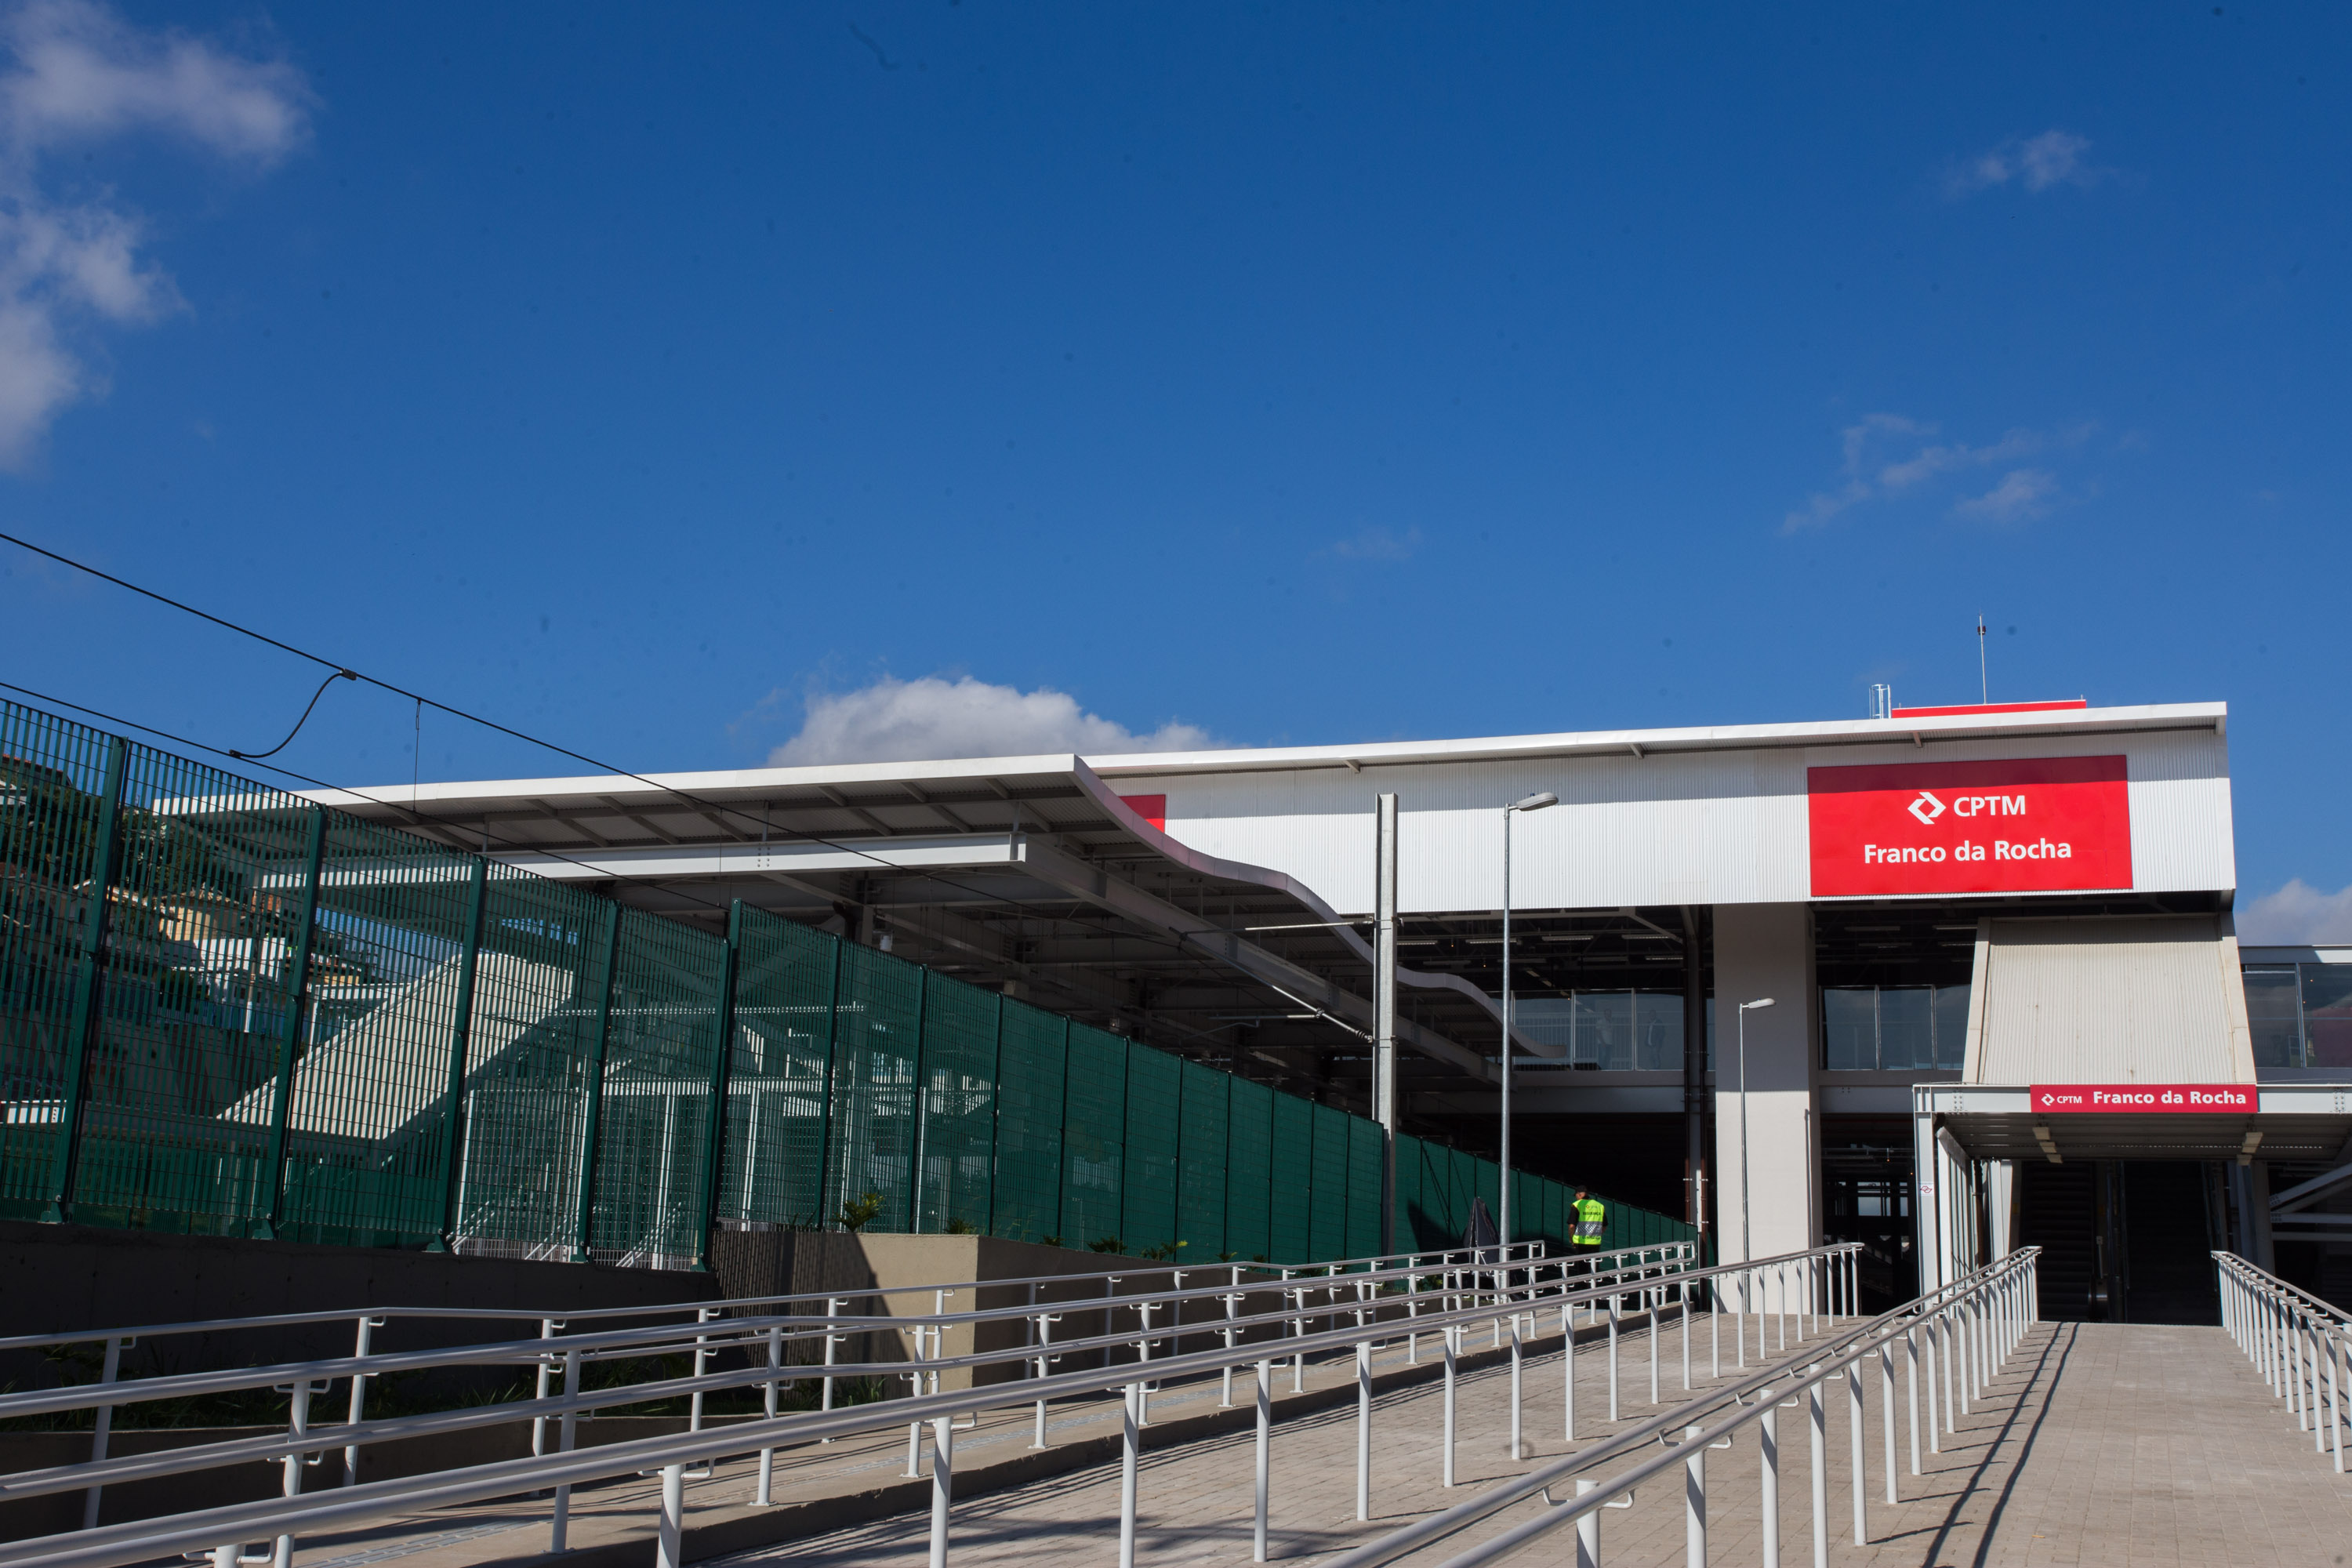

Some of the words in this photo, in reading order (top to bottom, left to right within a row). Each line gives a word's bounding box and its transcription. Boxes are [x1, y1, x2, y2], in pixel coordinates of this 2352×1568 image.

[1954, 795, 2025, 817] CPTM
[1864, 844, 1947, 864] Franco
[1955, 840, 1986, 861] da
[1994, 837, 2072, 861] Rocha
[2056, 1095, 2082, 1104] CPTM
[2093, 1091, 2154, 1104] Franco
[2161, 1091, 2183, 1104] da
[2190, 1091, 2246, 1104] Rocha
